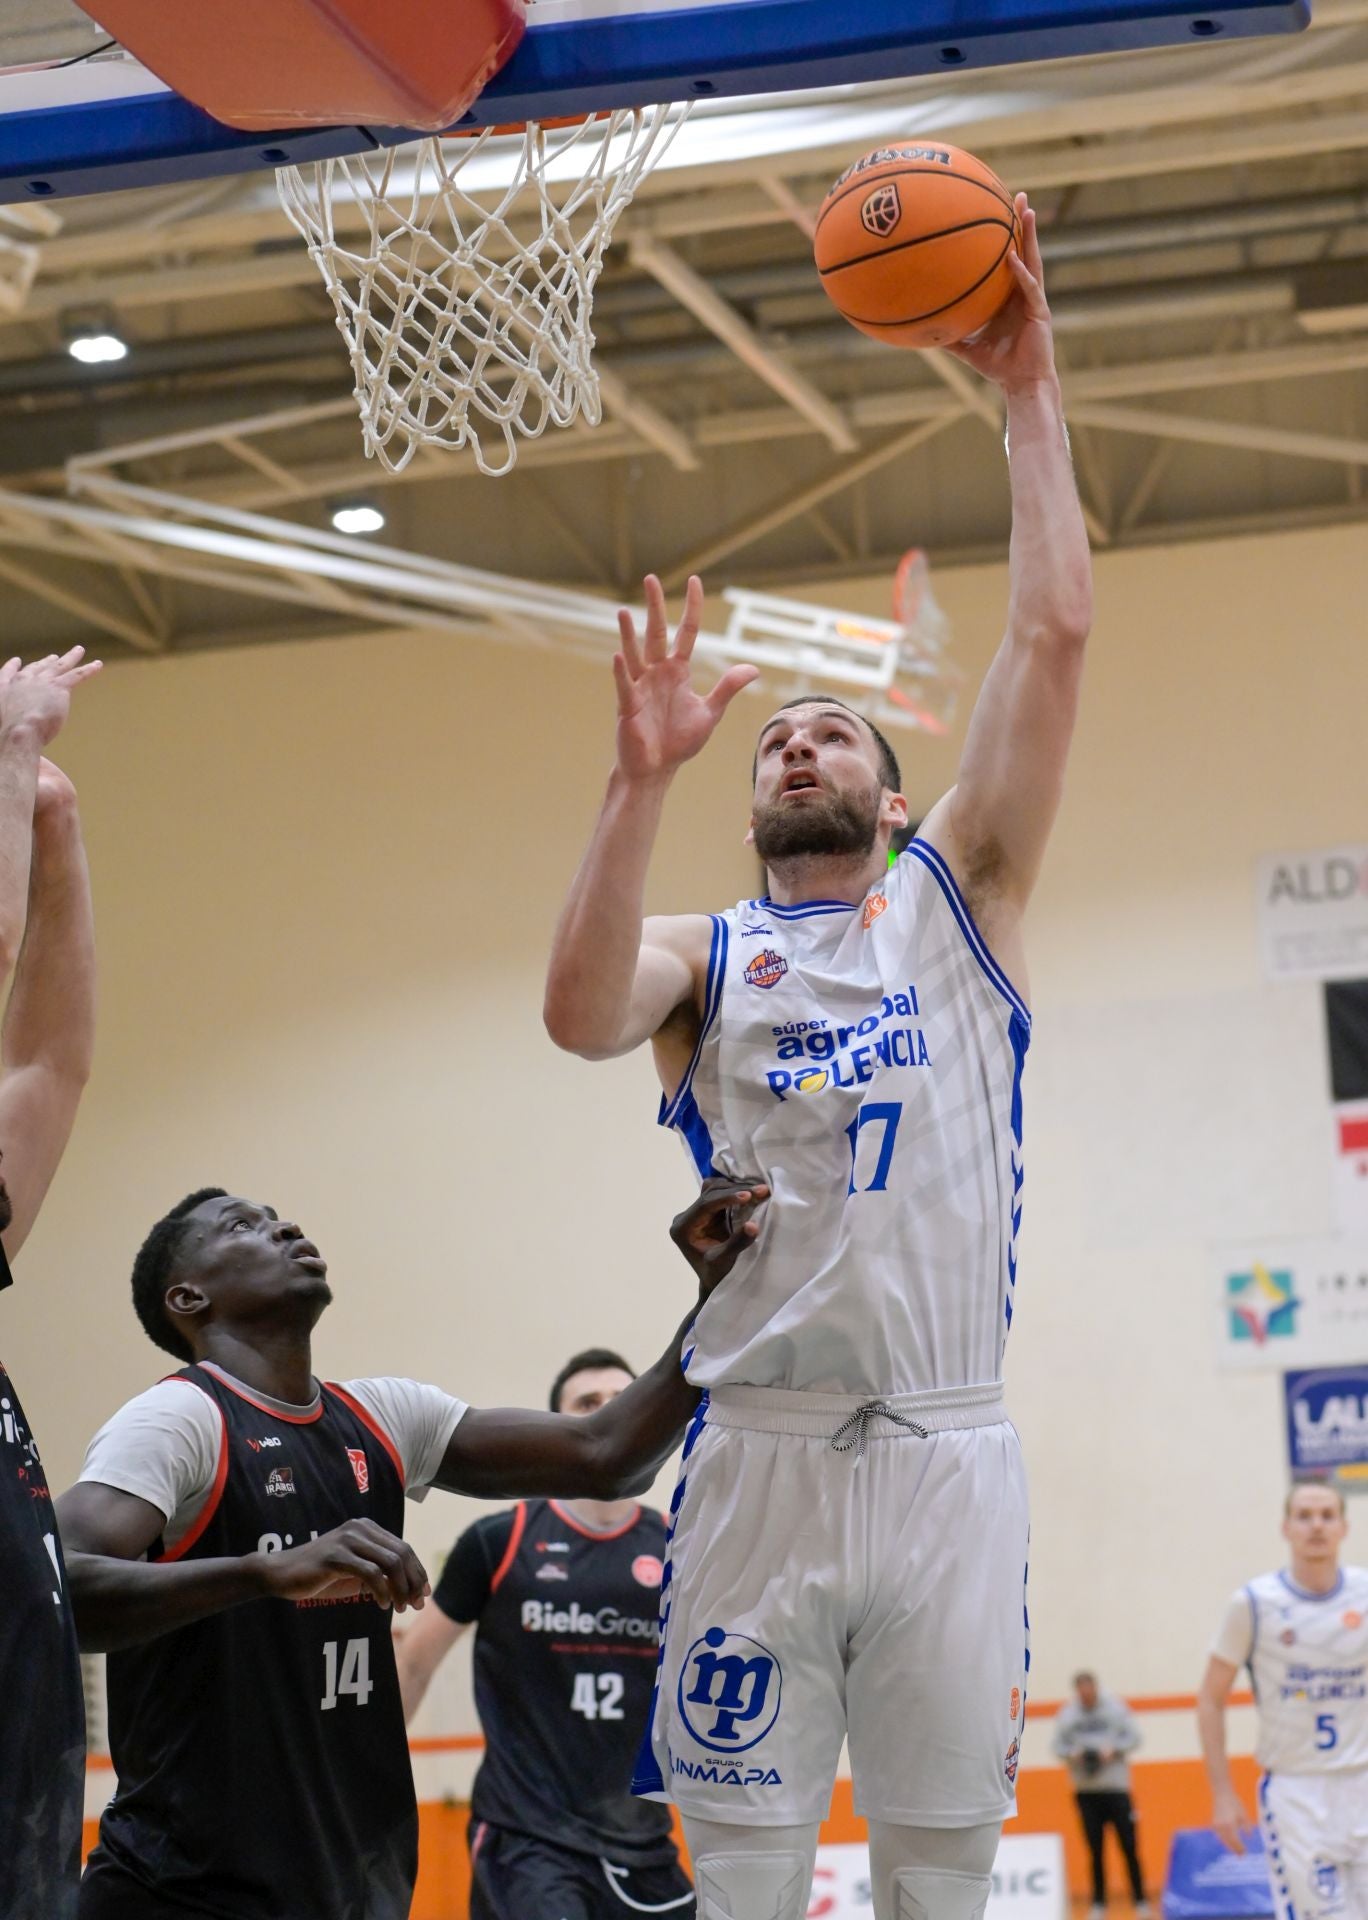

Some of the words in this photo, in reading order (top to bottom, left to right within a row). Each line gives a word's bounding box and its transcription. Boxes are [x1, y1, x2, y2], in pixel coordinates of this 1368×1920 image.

[744, 962, 788, 981] PALENCIA
[771, 1017, 829, 1037] súper
[320, 1636, 374, 1711] 14
[570, 1672, 625, 1720] 42
[1315, 1714, 1338, 1750] 5
[705, 1758, 744, 1767] GRUPO
